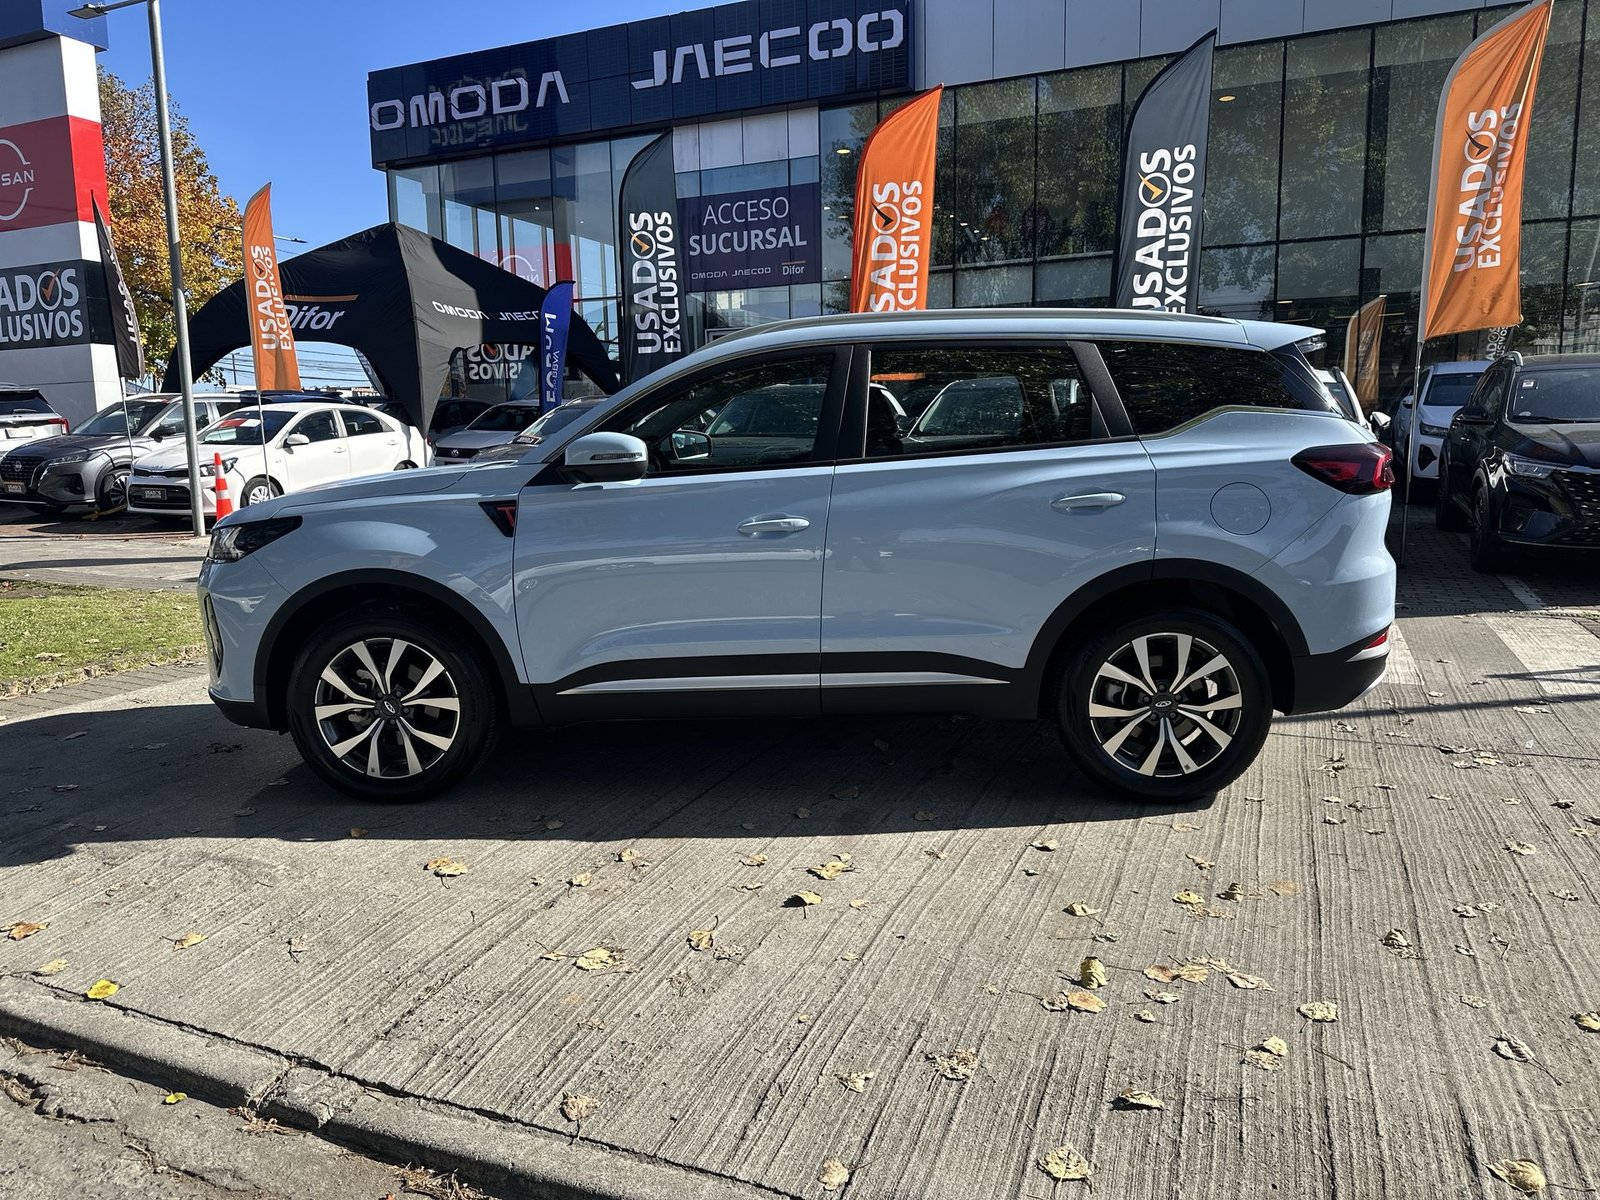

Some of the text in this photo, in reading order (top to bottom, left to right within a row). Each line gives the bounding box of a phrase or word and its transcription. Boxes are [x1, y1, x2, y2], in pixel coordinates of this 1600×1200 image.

[371, 71, 570, 131] OMODA
[631, 9, 904, 90] JAECOO
[689, 225, 807, 256] SUCURSAL
[703, 196, 789, 226] ACCESO
[1454, 109, 1497, 272] USADOS
[1477, 103, 1521, 269] EXCLUSIVOS
[251, 245, 279, 350] USADOS
[629, 212, 662, 354] USADOS
[654, 211, 681, 353] EXCLUSIVOS
[691, 266, 772, 280] OMODA JAECOO
[782, 265, 805, 275] Difor
[896, 180, 922, 312] CLUSIVOS
[432, 300, 489, 320] OMODA
